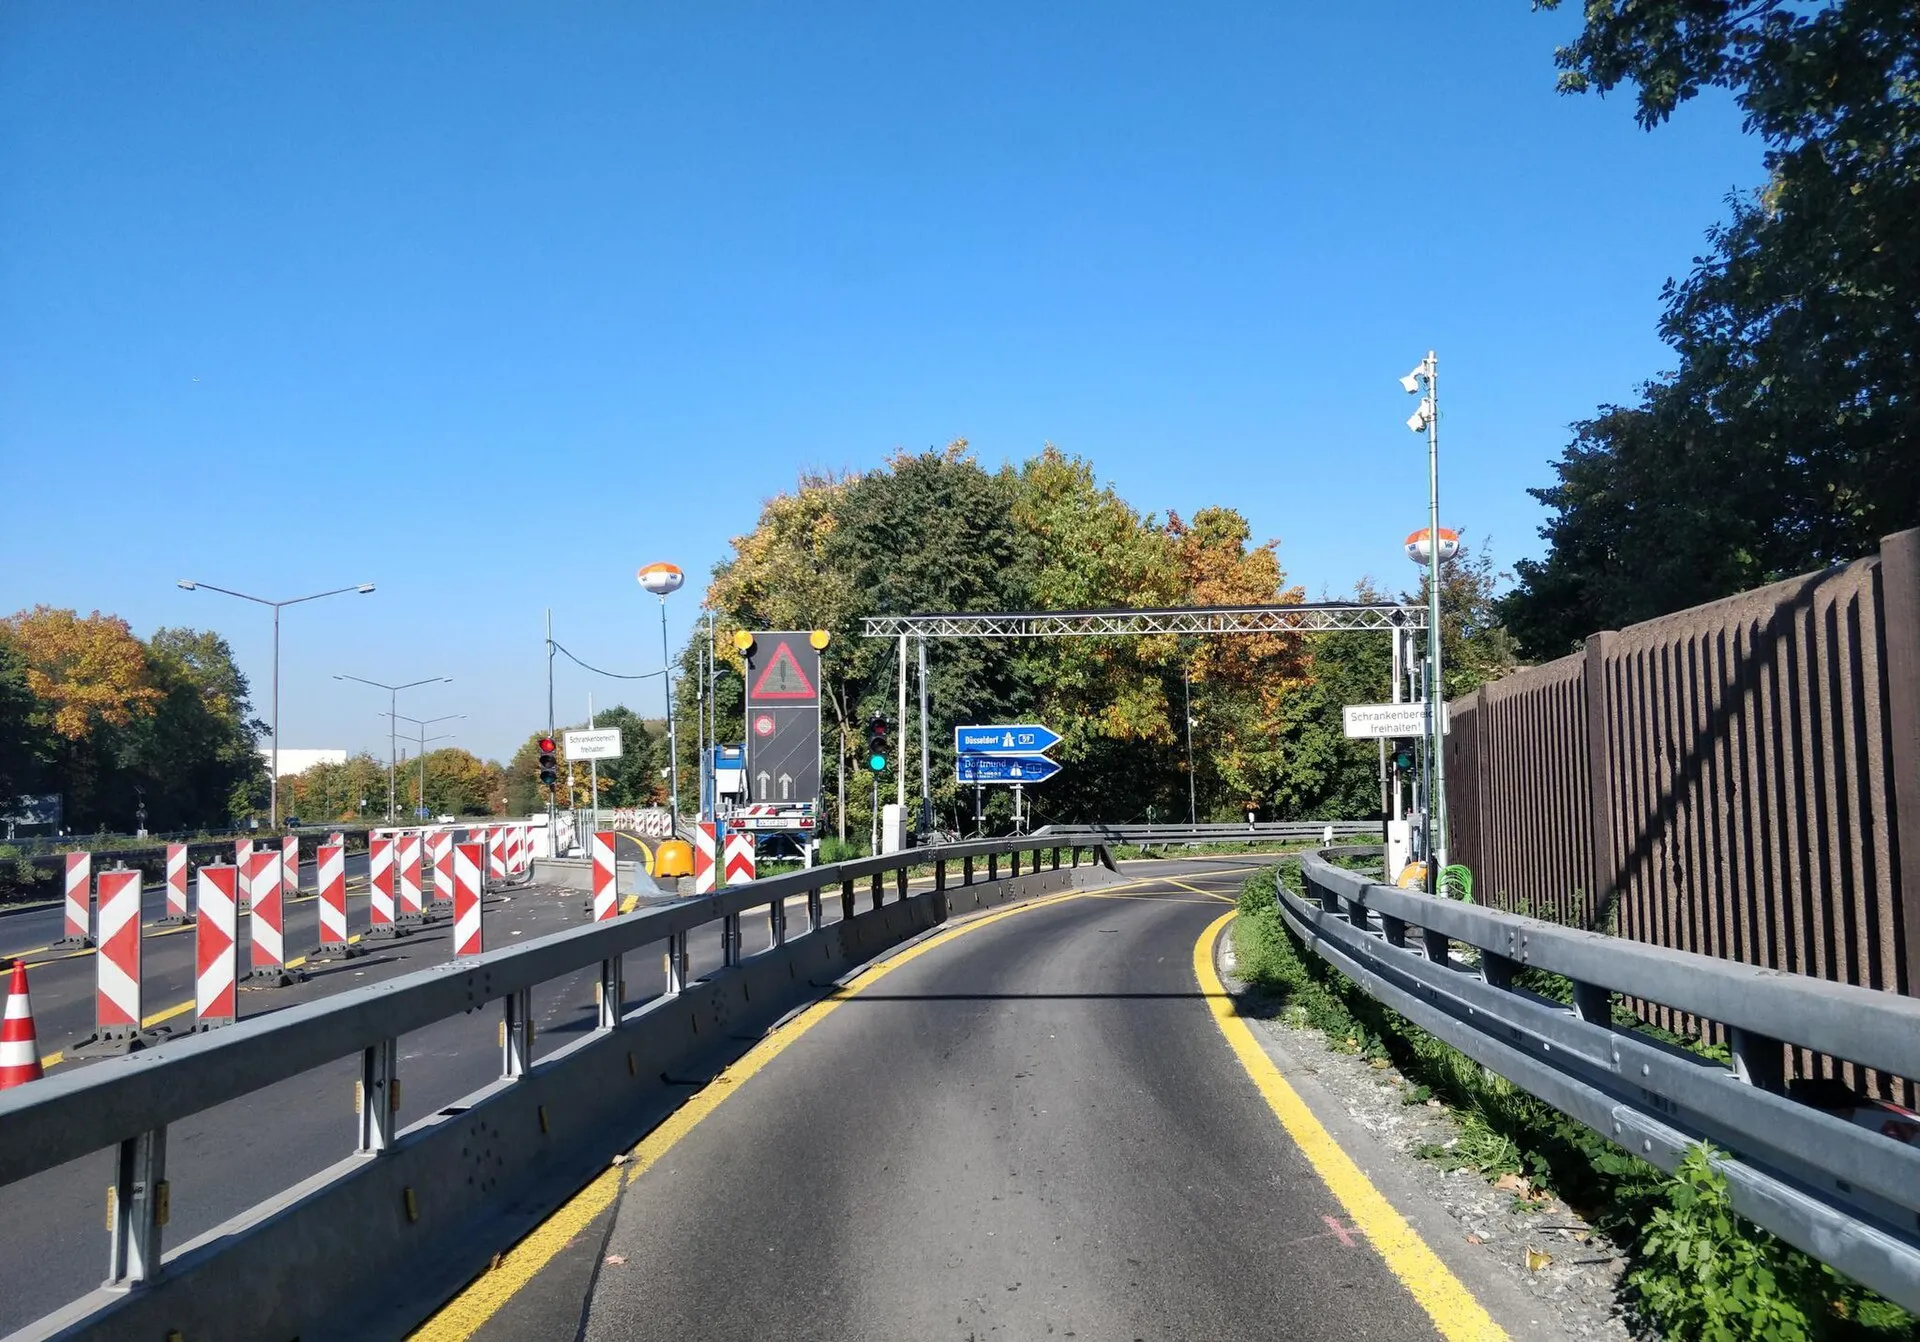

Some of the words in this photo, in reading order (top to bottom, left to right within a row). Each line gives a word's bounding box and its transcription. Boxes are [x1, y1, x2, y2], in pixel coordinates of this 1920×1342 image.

[1351, 710, 1433, 721] Schrankenbereic
[1370, 723, 1421, 733] freihalten!
[965, 736, 999, 744] Düsseldorf
